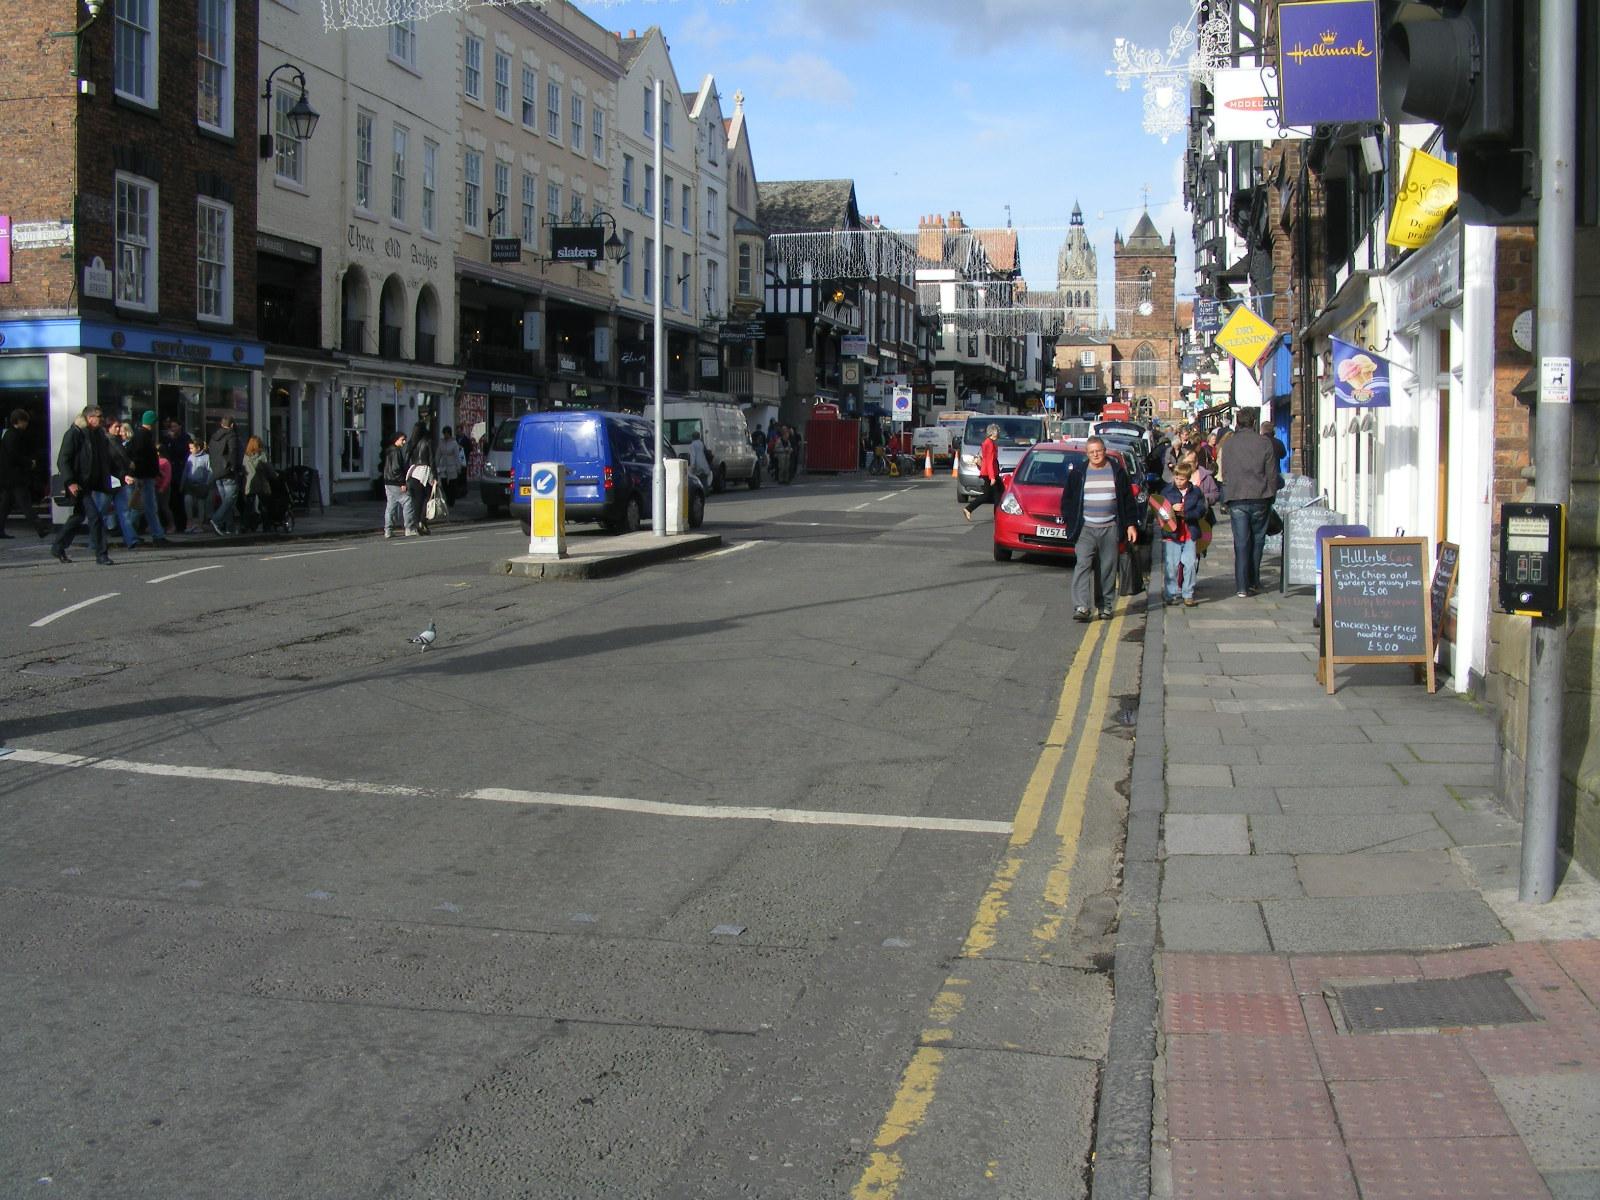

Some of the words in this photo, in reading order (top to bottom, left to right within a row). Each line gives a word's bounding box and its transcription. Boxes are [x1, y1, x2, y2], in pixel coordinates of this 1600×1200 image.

[1287, 40, 1373, 65] Hallmark
[348, 224, 375, 252] Three
[385, 237, 401, 258] Old
[411, 244, 437, 271] Arches
[557, 246, 598, 258] slaters
[1234, 325, 1255, 336] DRY
[1223, 335, 1271, 348] CLEANING
[1039, 527, 1060, 536] RY57
[1340, 549, 1387, 564] Hilltribe
[1334, 570, 1359, 580] Fish,
[1361, 570, 1386, 580] Chips
[1390, 571, 1408, 579] and
[1338, 581, 1367, 590] garden
[1379, 580, 1404, 589] mushy
[1362, 587, 1389, 596] £5.00
[1393, 625, 1417, 633] fried
[1397, 634, 1417, 643] soup
